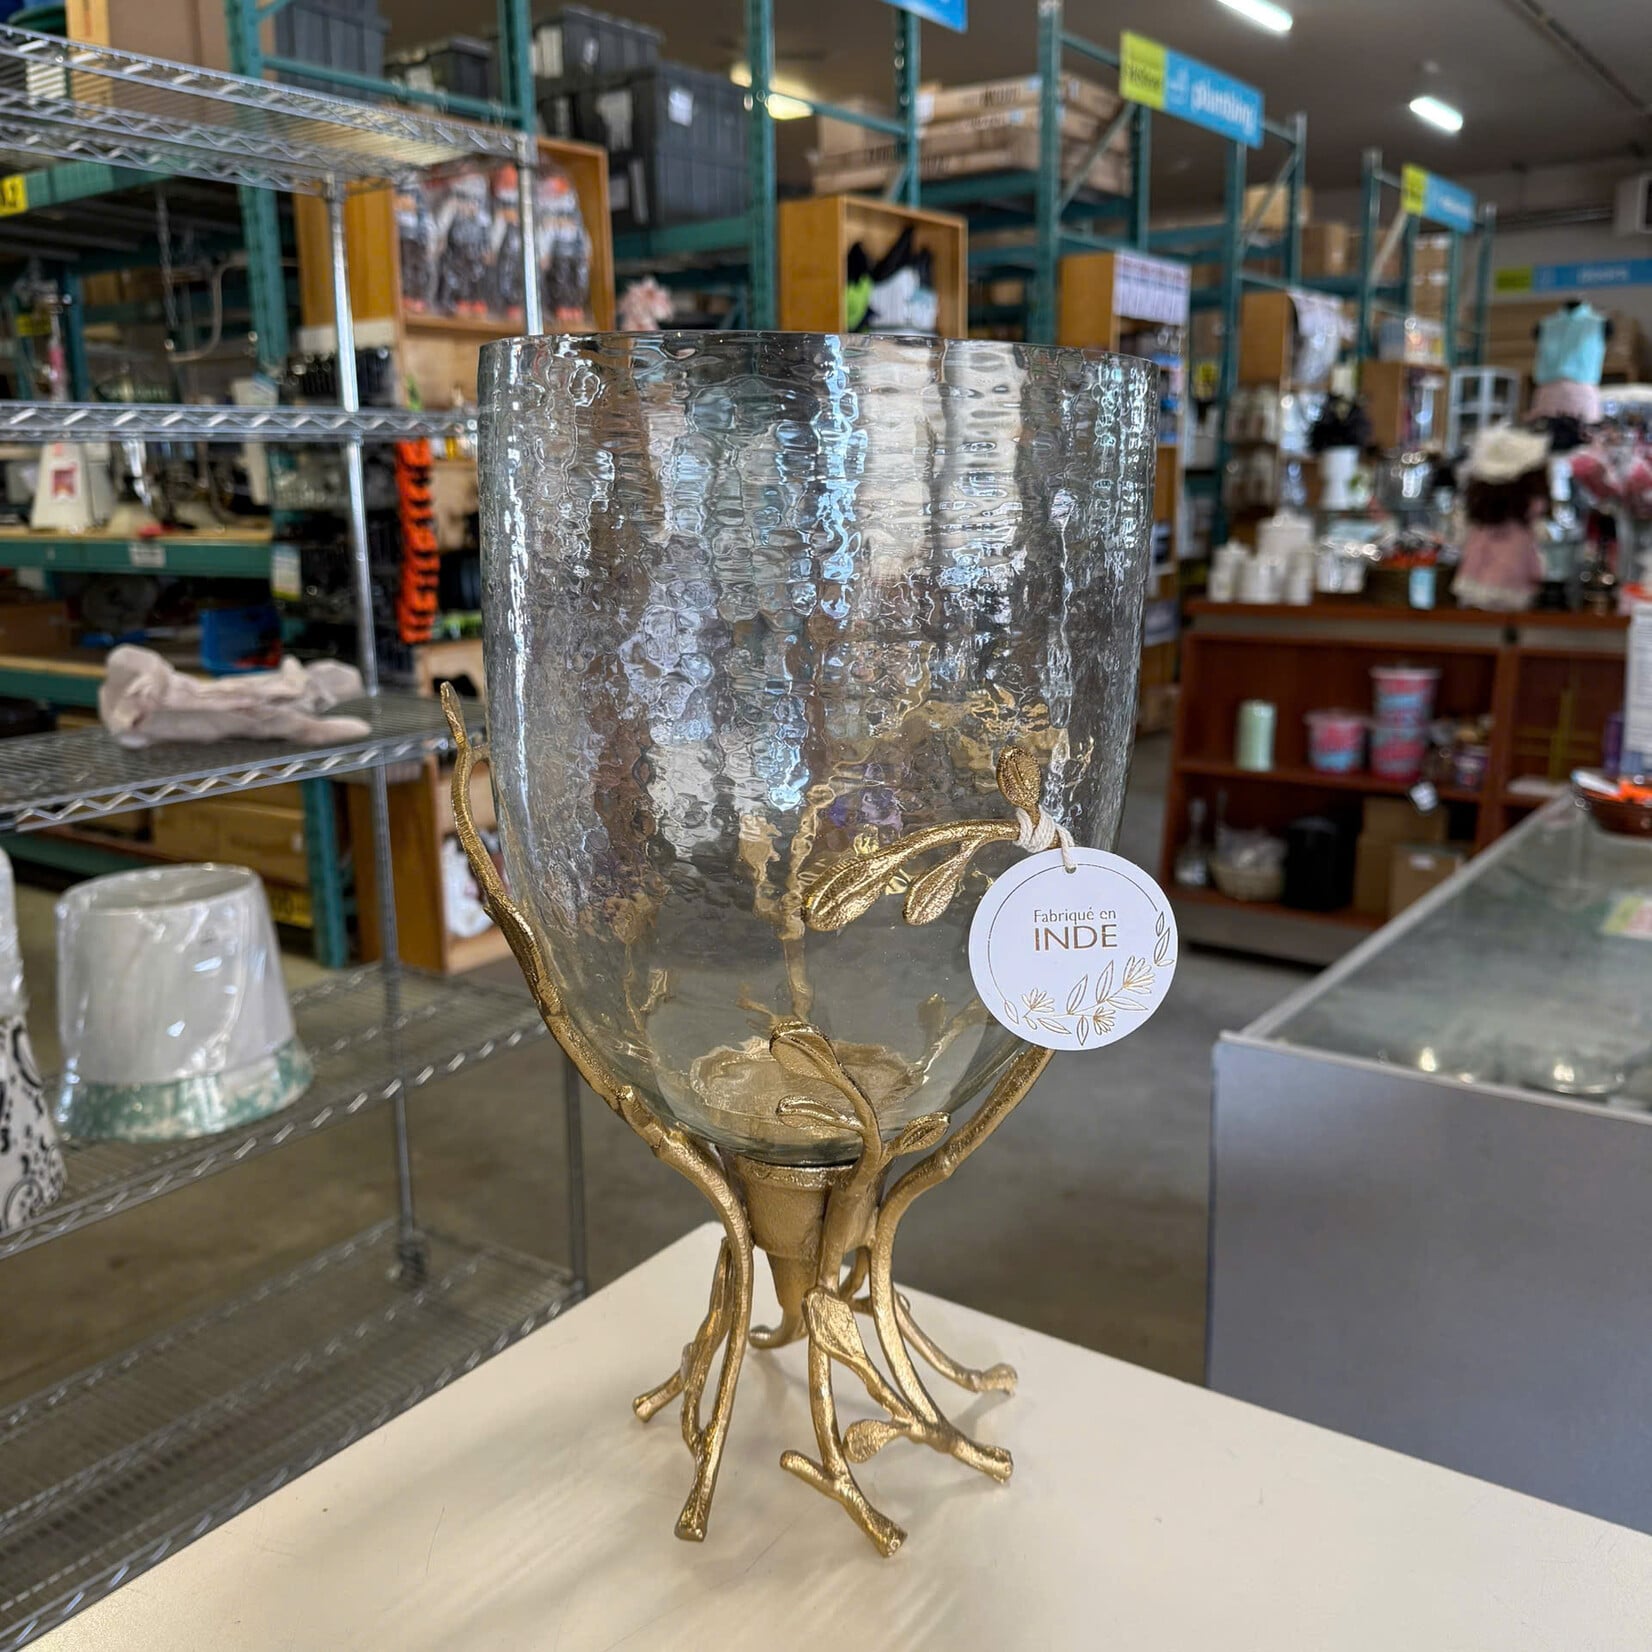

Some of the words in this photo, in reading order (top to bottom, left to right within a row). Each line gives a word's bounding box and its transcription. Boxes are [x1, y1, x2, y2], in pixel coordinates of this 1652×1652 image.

[1190, 79, 1255, 137] plumbing
[1033, 906, 1095, 925] Fabriqué
[1099, 909, 1117, 920] en
[1034, 923, 1118, 951] INDE
